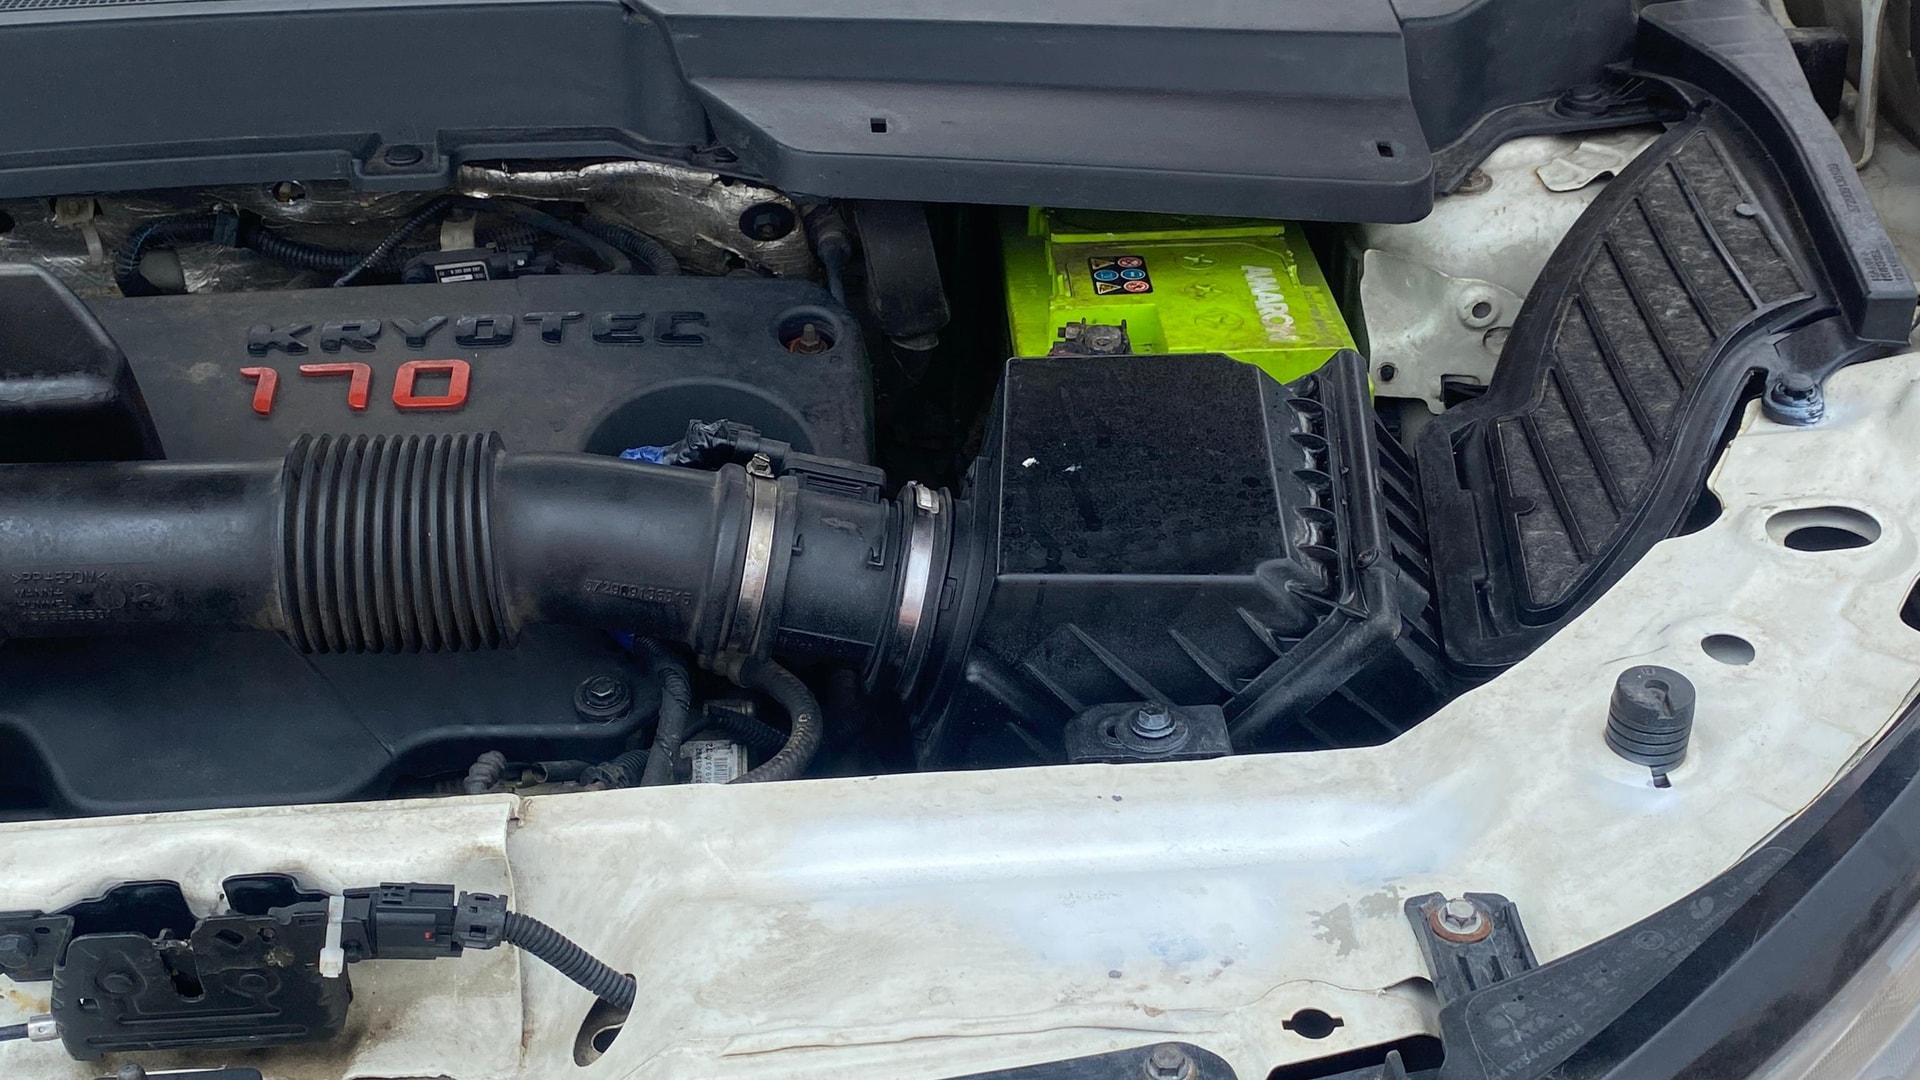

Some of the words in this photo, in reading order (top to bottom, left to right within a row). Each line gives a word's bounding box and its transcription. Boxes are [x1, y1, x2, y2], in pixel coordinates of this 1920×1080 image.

[1241, 265, 1300, 342] AMARON
[247, 311, 707, 357] KRYOTEC
[239, 358, 471, 417] 170
